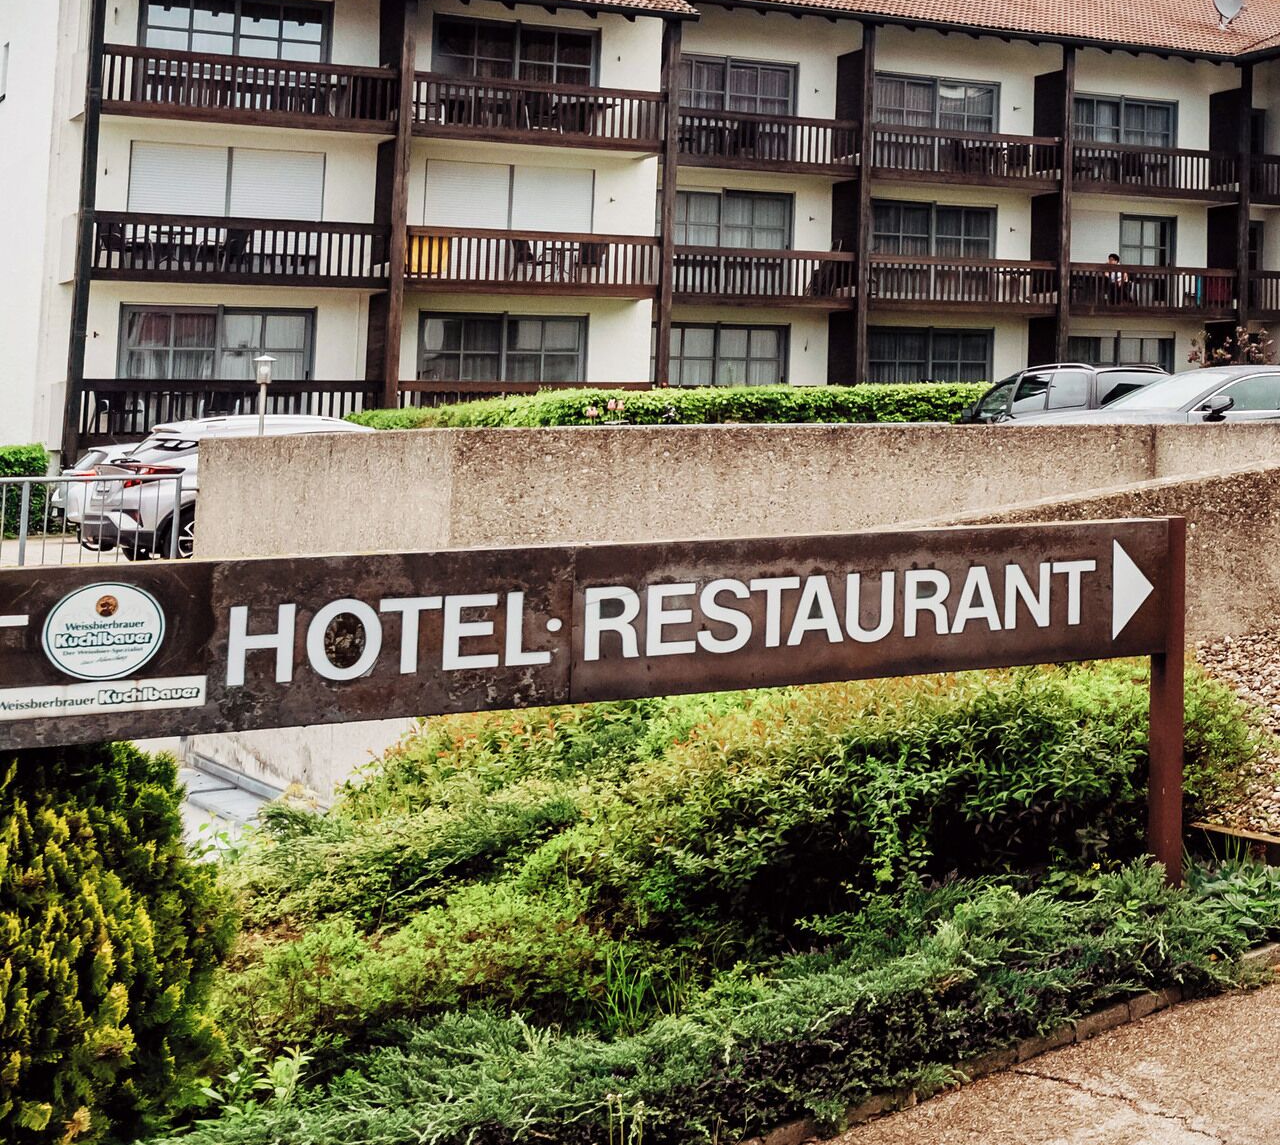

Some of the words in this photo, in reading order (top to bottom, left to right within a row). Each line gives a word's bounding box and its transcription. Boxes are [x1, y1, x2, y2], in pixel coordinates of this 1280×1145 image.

[584, 559, 1097, 661] RESTAURANT
[65, 620, 145, 631] Weissbierbrauer
[55, 631, 152, 649] Kuchlbauer
[98, 686, 200, 705] Kuchlbauer
